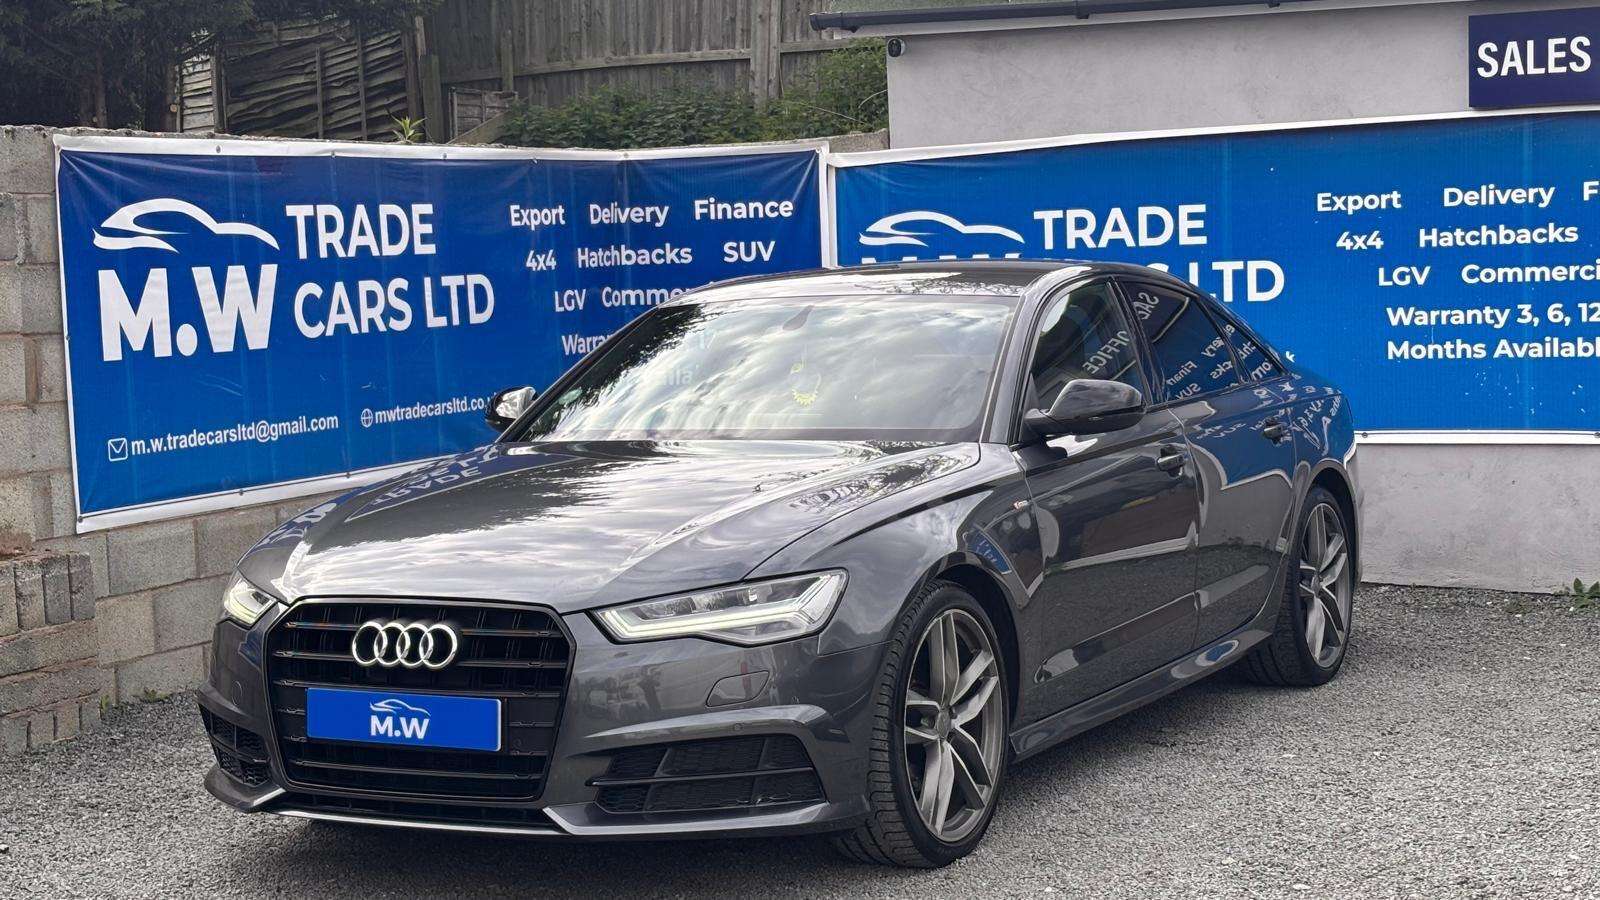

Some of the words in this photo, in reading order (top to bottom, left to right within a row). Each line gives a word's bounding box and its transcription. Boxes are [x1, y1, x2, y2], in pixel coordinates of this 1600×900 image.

[1477, 36, 1592, 78] SALES
[508, 204, 566, 231] Export
[589, 202, 670, 228] Delivery
[694, 196, 794, 221] Finance
[1316, 190, 1402, 215] Export
[1443, 183, 1556, 208] Delivery
[286, 203, 437, 259] TRADE
[1033, 203, 1208, 249] TRADE
[1336, 230, 1384, 250] 4x4
[1419, 222, 1579, 248] Hatchbacks
[525, 249, 557, 272] 4x4
[577, 242, 693, 268] Hatchbacks
[723, 240, 776, 262] SUV
[1378, 265, 1431, 286] LGV
[97, 263, 278, 362] M.W
[293, 276, 413, 339] CARS
[424, 273, 495, 328] LTD
[554, 288, 587, 313] LGV
[1386, 306, 1510, 329] Warranty
[1516, 303, 1540, 327] 3,
[1547, 302, 1571, 327] 6,
[1387, 338, 1487, 360] Months
[131, 414, 339, 456] m.w.tradecarsltd@gmail.com
[370, 714, 430, 740] M.W
